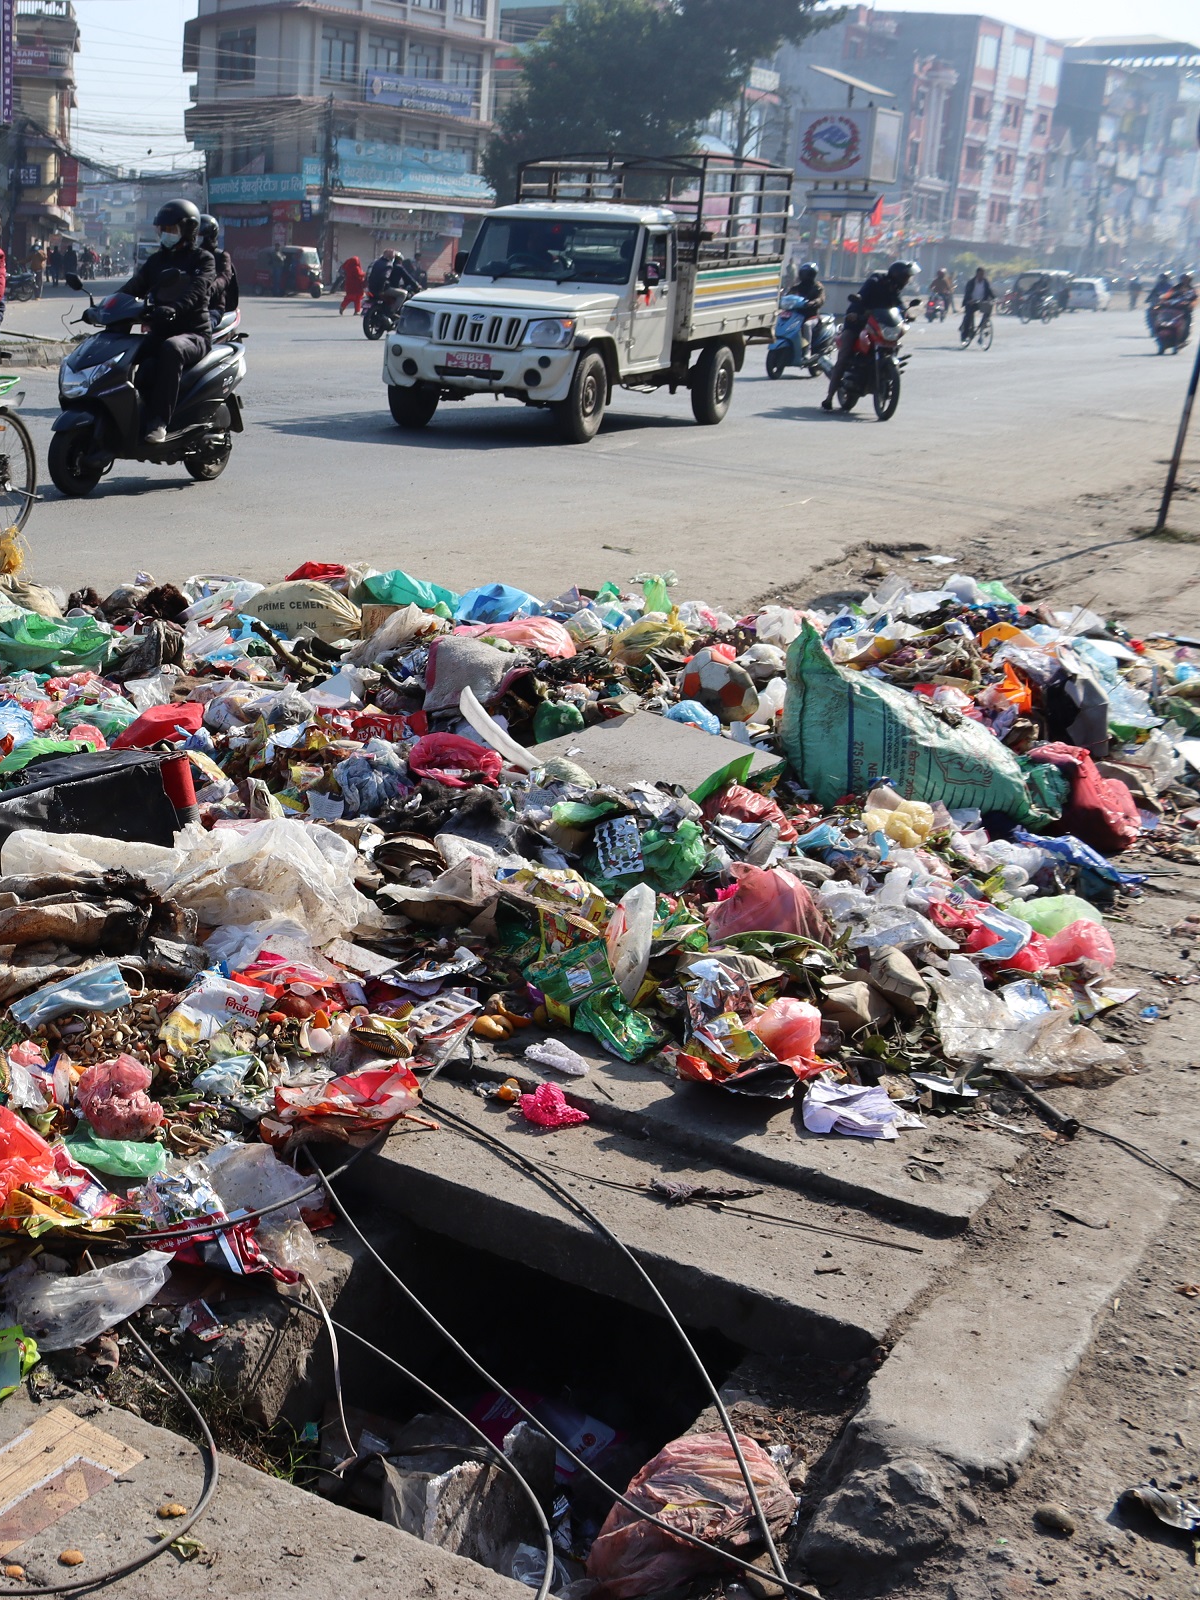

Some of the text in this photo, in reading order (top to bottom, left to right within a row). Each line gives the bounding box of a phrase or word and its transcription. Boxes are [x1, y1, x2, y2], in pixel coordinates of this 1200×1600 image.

[258, 602, 285, 612] PRIME
[853, 741, 864, 757] 275
[868, 763, 878, 778] NE
